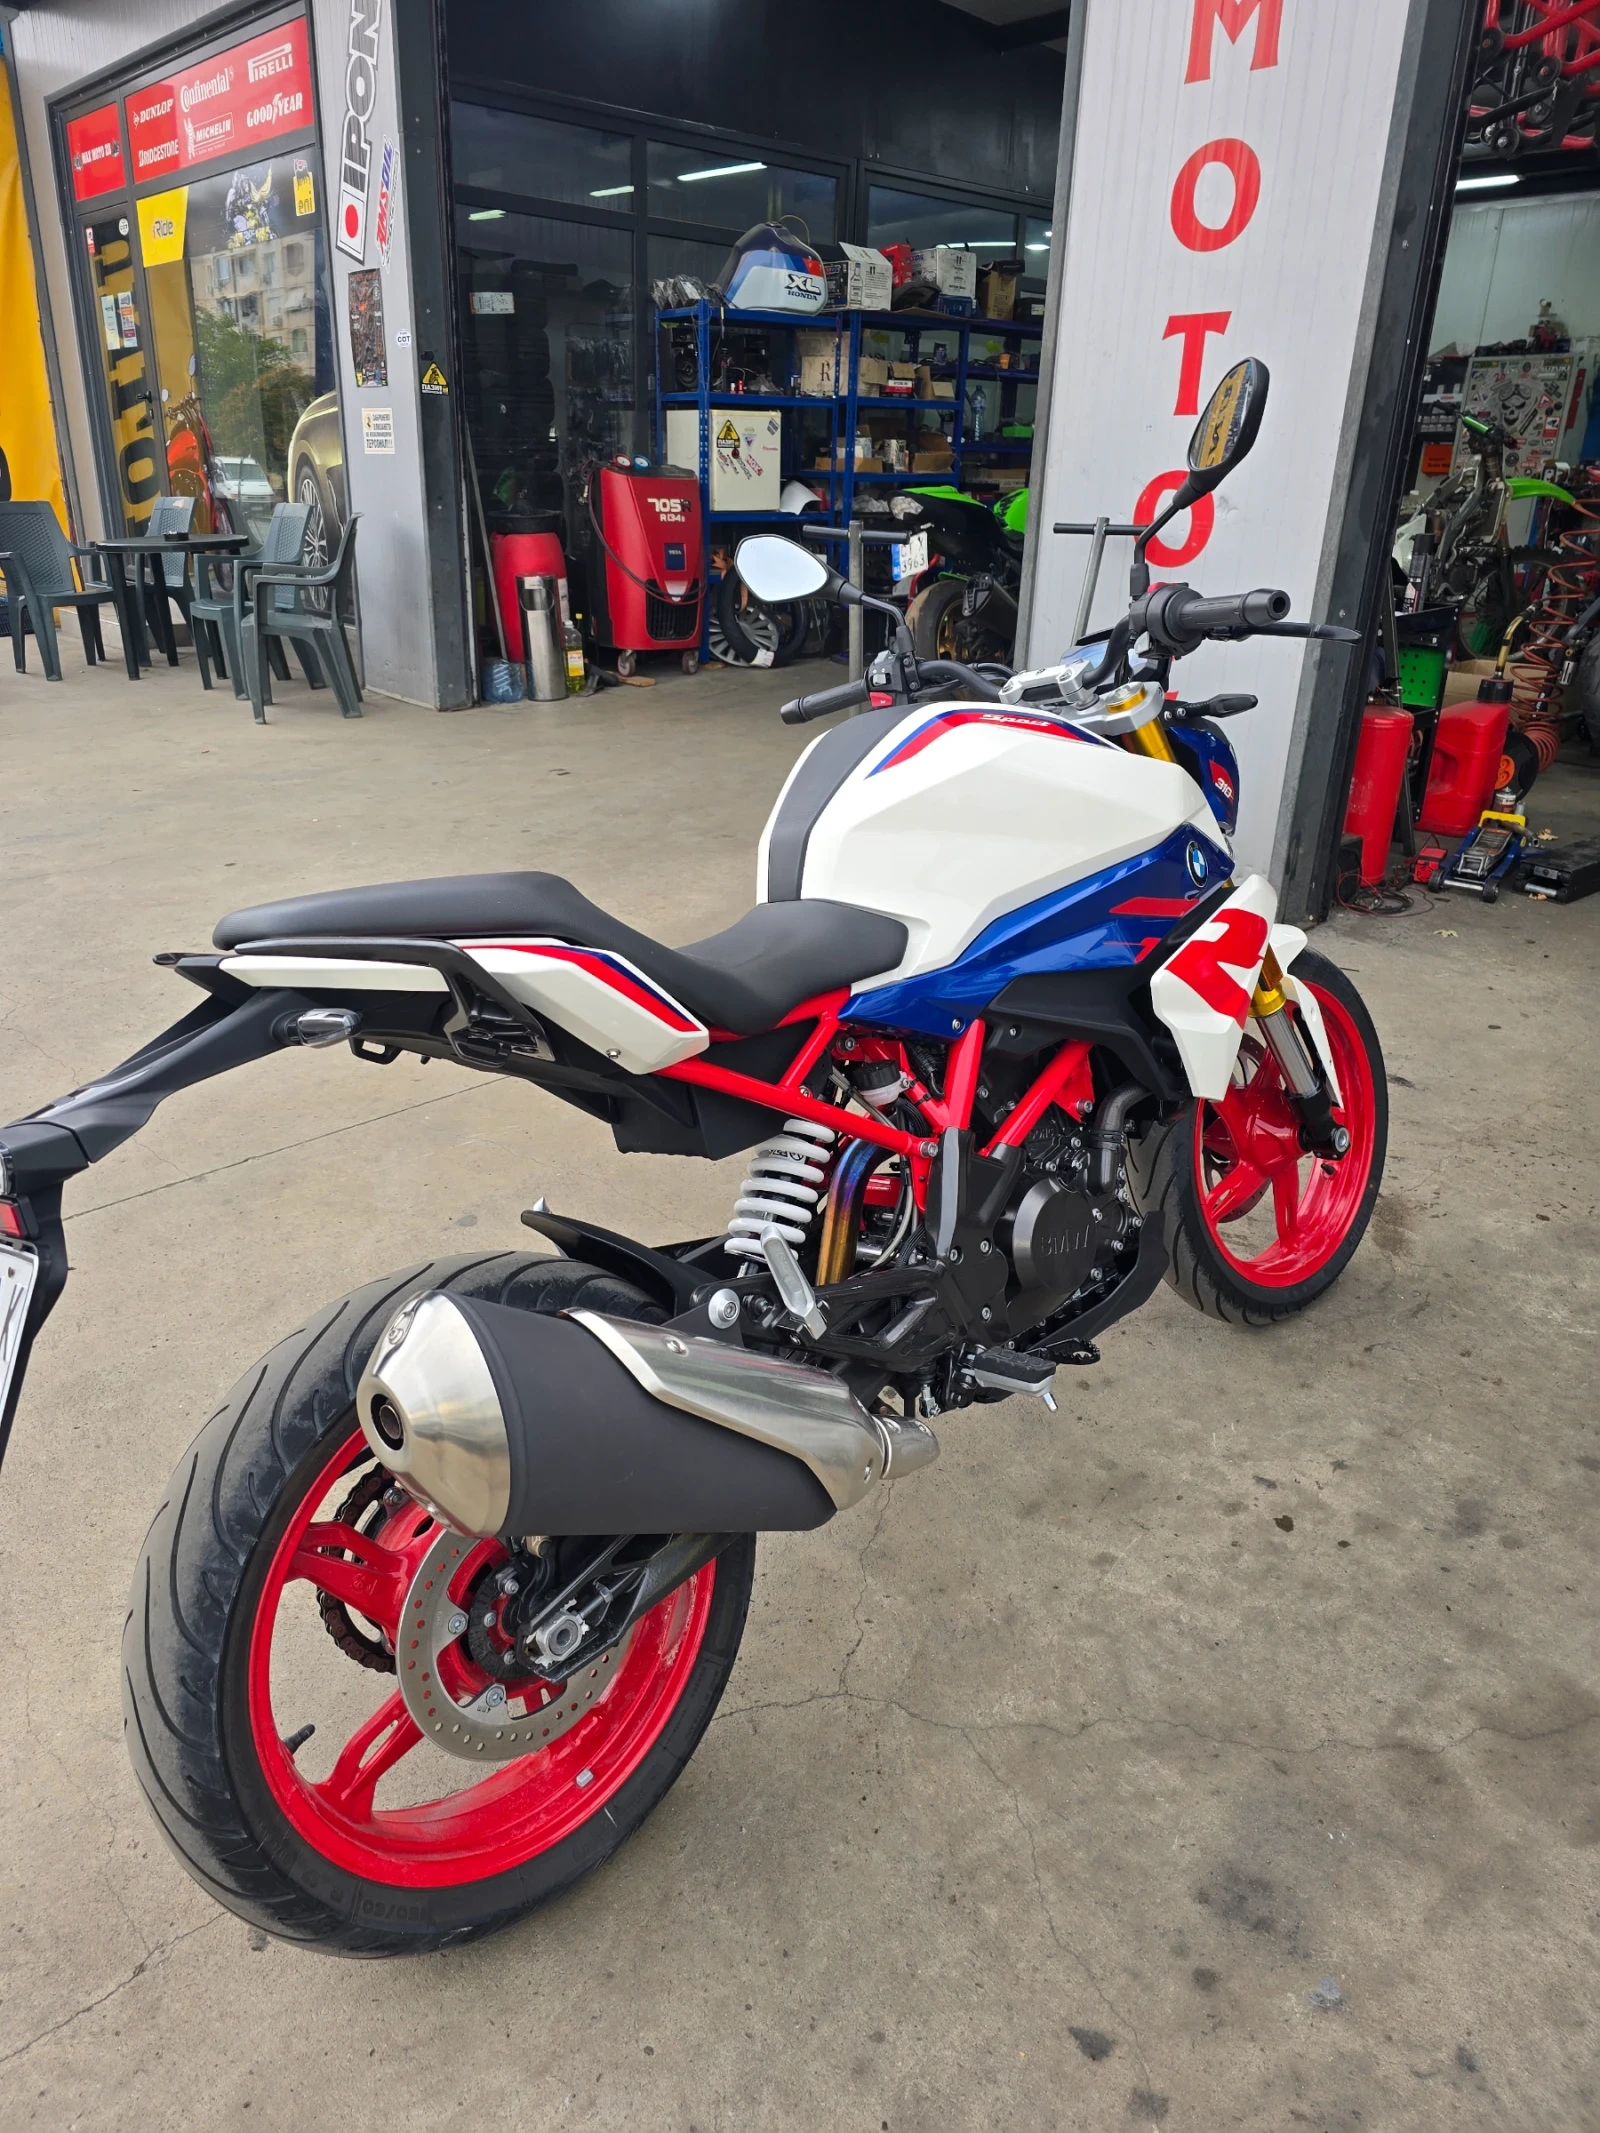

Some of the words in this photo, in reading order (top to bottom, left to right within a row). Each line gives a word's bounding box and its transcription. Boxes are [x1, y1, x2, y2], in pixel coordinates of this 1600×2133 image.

[247, 42, 294, 84] PIRELLI
[180, 67, 231, 113] Continental
[139, 98, 174, 123] DUNLOP
[246, 92, 304, 128] GOODYEAR
[196, 118, 231, 143] MICHELIN
[138, 138, 180, 168] BRIDGESTONE
[784, 273, 821, 295] XL
[787, 289, 818, 301] HONDA
[1214, 777, 1233, 799] 310
